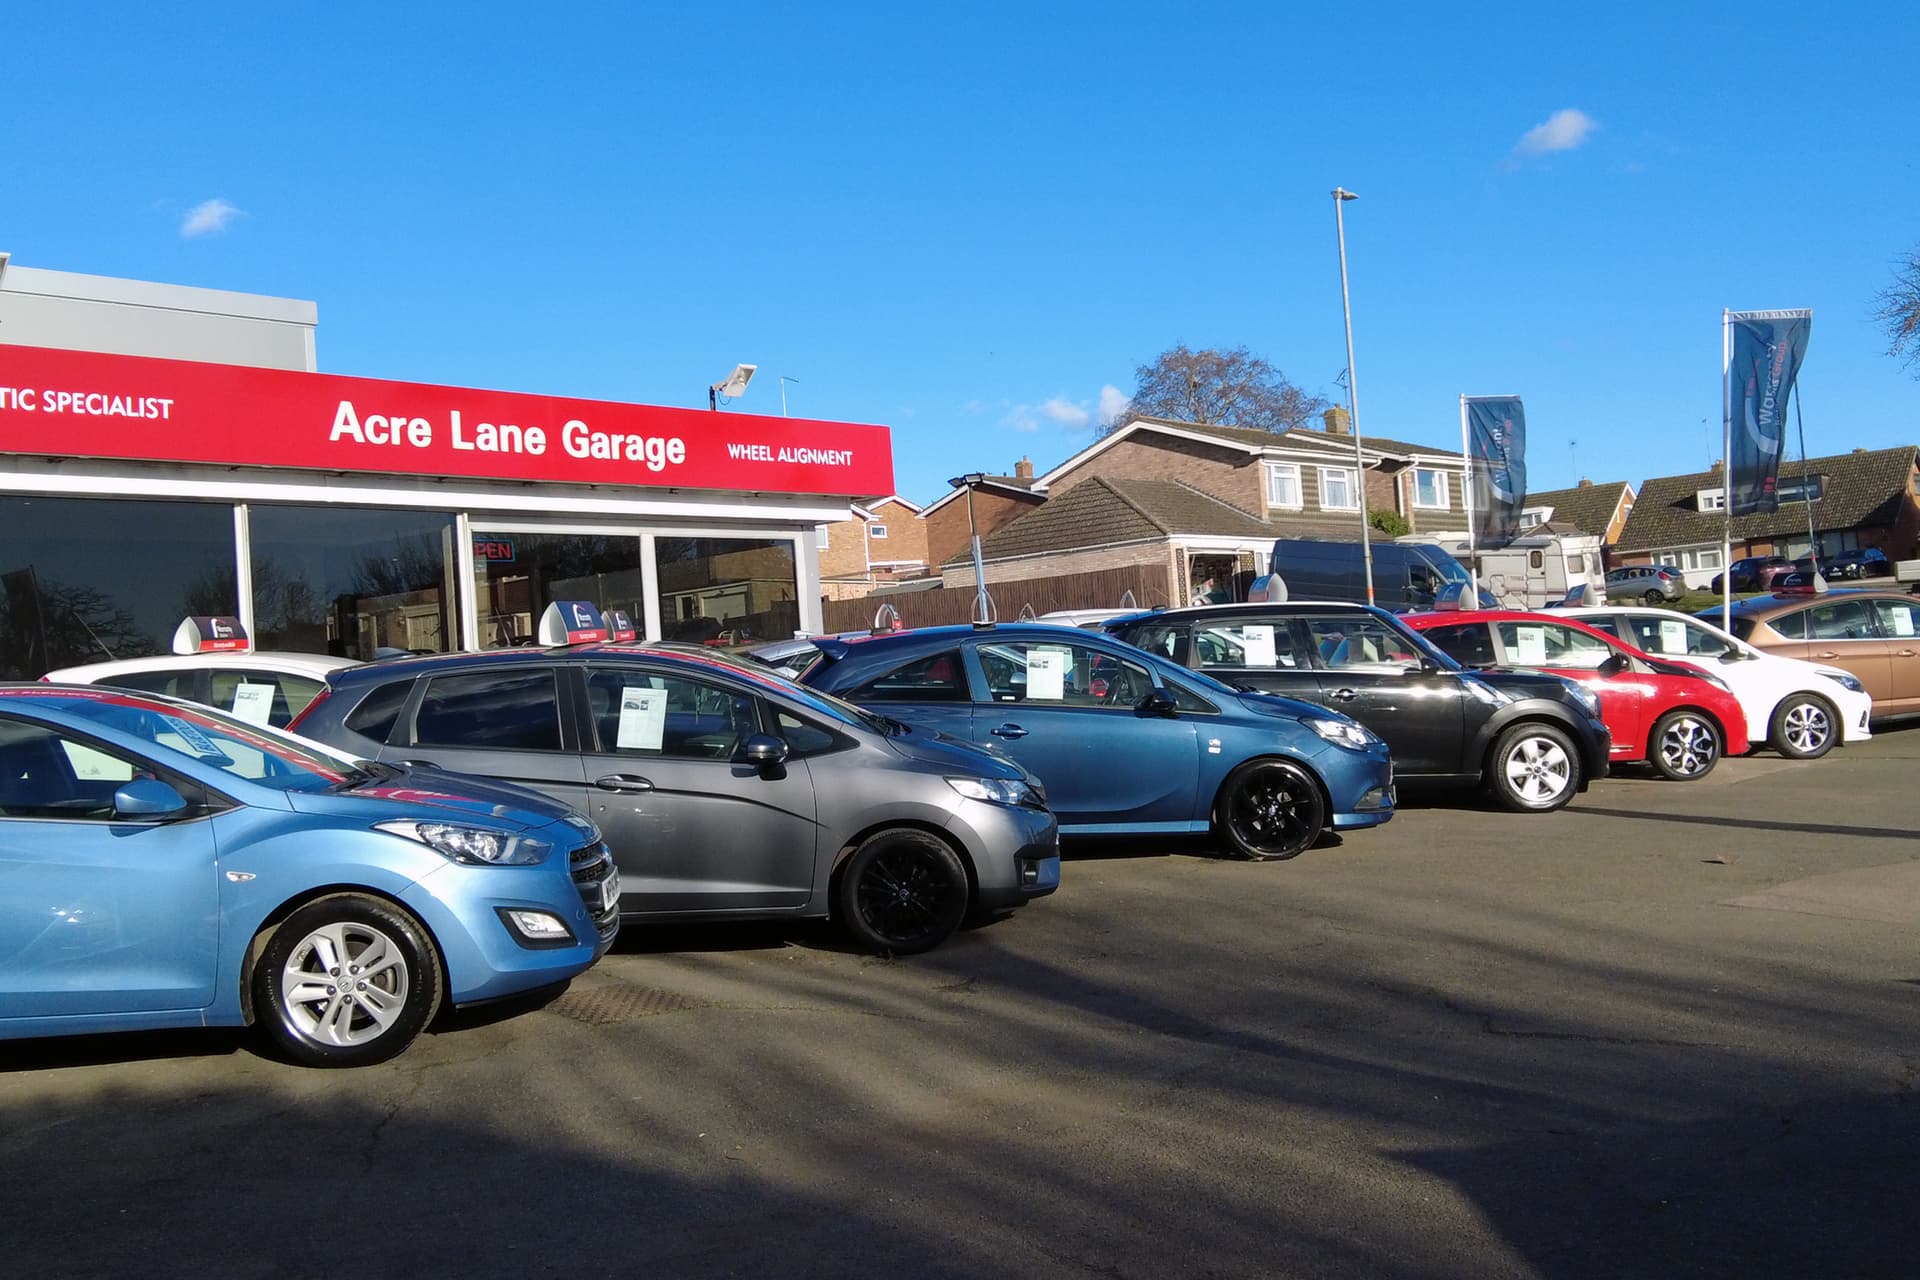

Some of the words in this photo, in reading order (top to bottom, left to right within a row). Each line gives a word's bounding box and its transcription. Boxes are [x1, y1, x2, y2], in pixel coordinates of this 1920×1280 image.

[0, 387, 36, 411] TIC
[43, 390, 174, 419] SPECIALIST
[329, 400, 433, 448] Acre
[450, 410, 547, 455] Lane
[561, 419, 686, 472] Garage
[727, 443, 775, 462] WHEEL
[777, 447, 853, 466] ALIGNMENT
[474, 542, 512, 559] PEN
